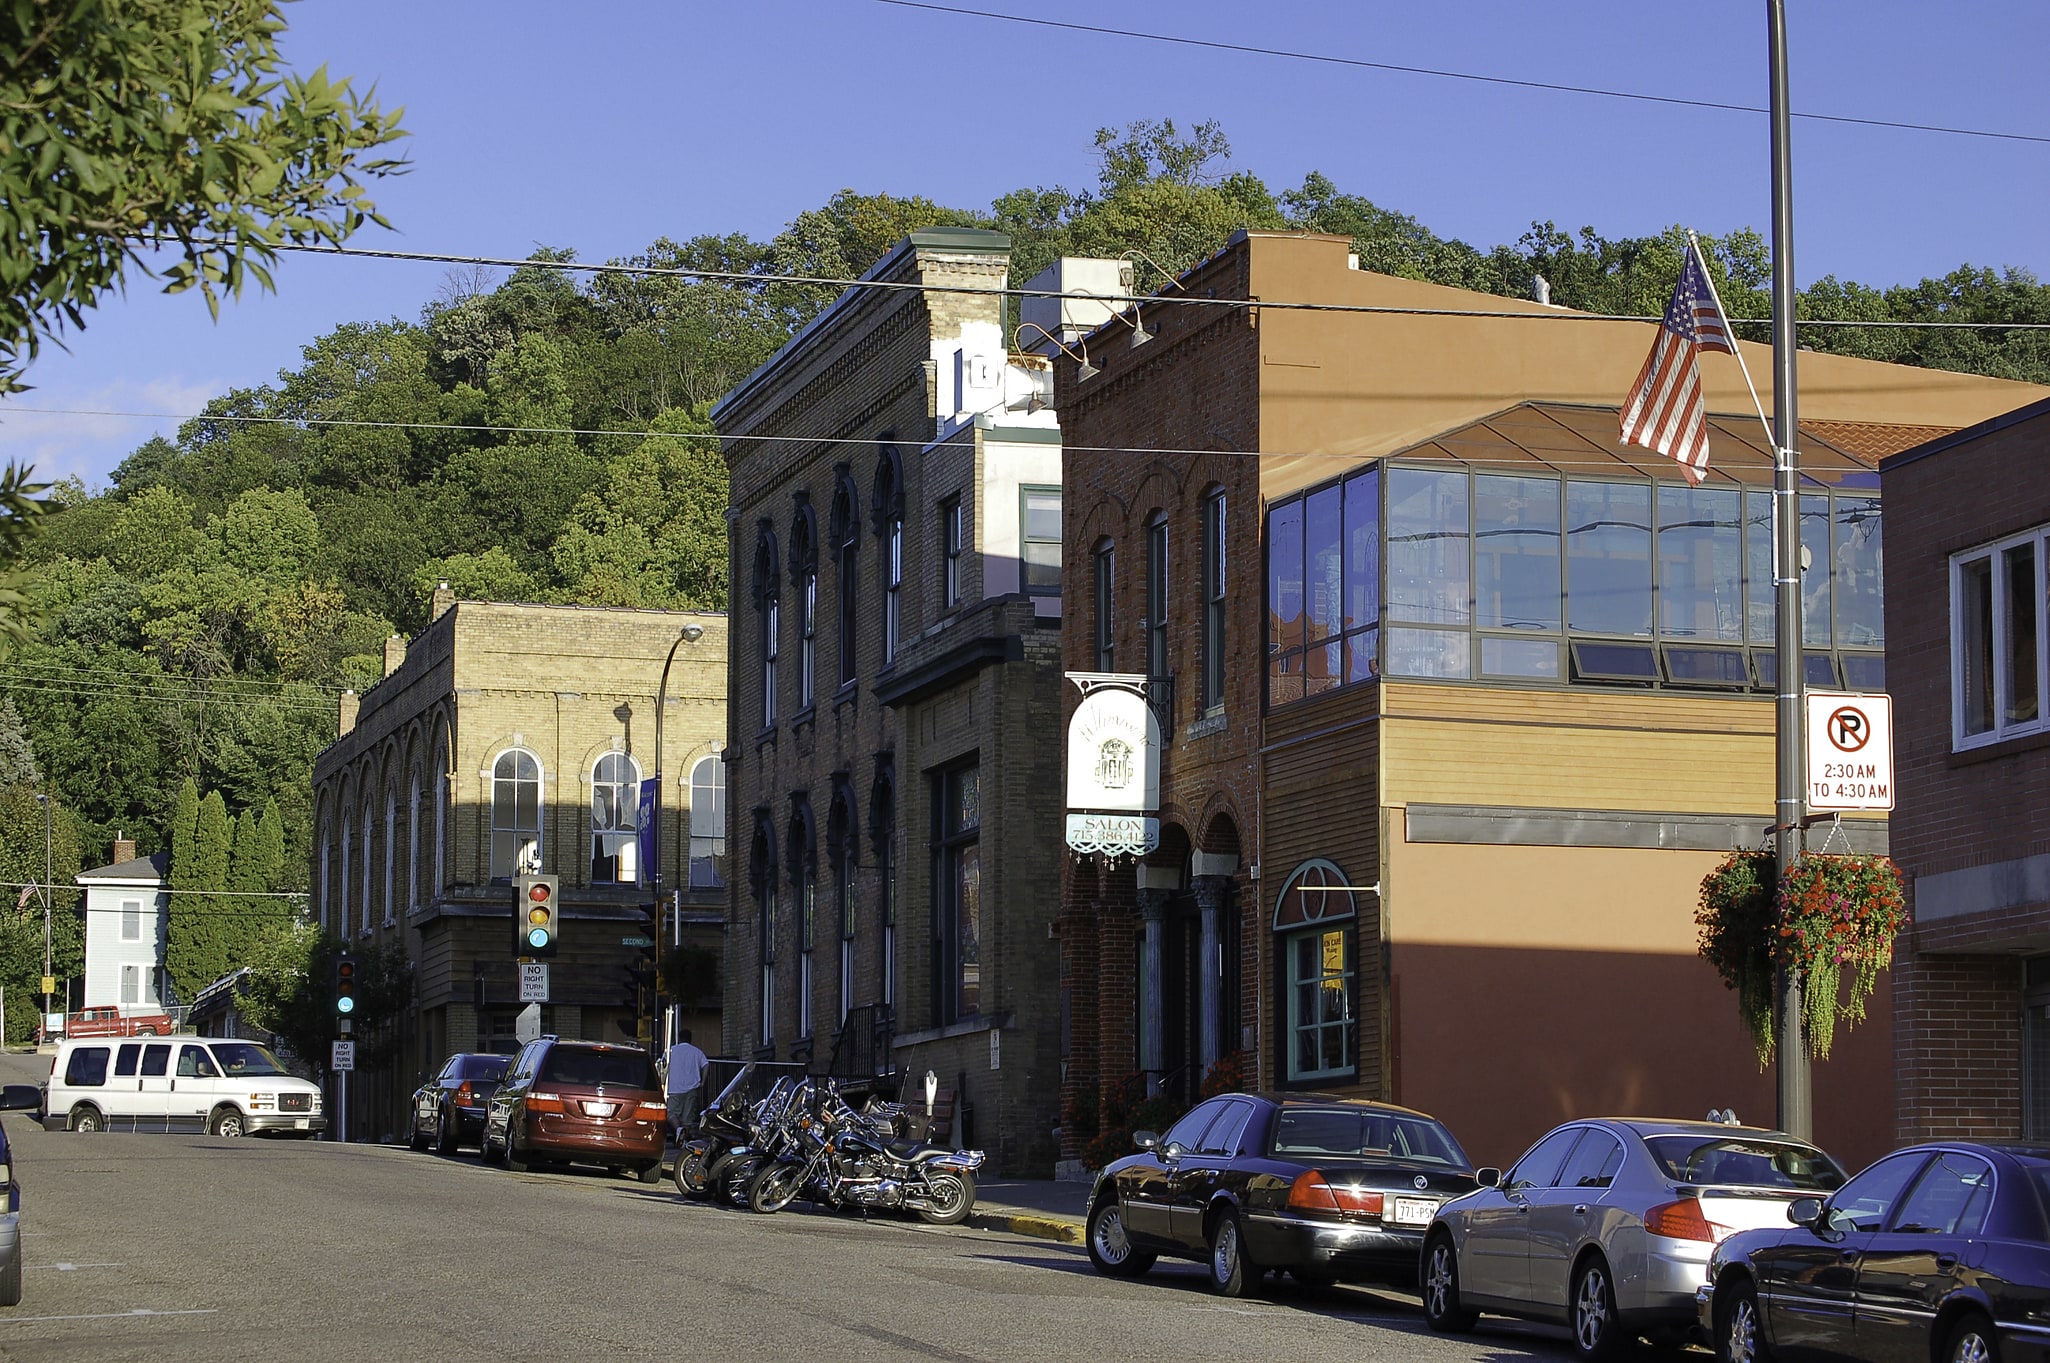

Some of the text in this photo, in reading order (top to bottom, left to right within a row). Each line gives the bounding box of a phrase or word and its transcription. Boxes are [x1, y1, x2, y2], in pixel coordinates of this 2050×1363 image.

[1824, 763, 1876, 779] 2:30 AM
[1813, 782, 1888, 799] TO 4:30 AM
[1085, 816, 1142, 831] SALON
[1072, 829, 1154, 843] 715.386.4122
[623, 941, 650, 950] SECOND
[527, 966, 541, 974] NO
